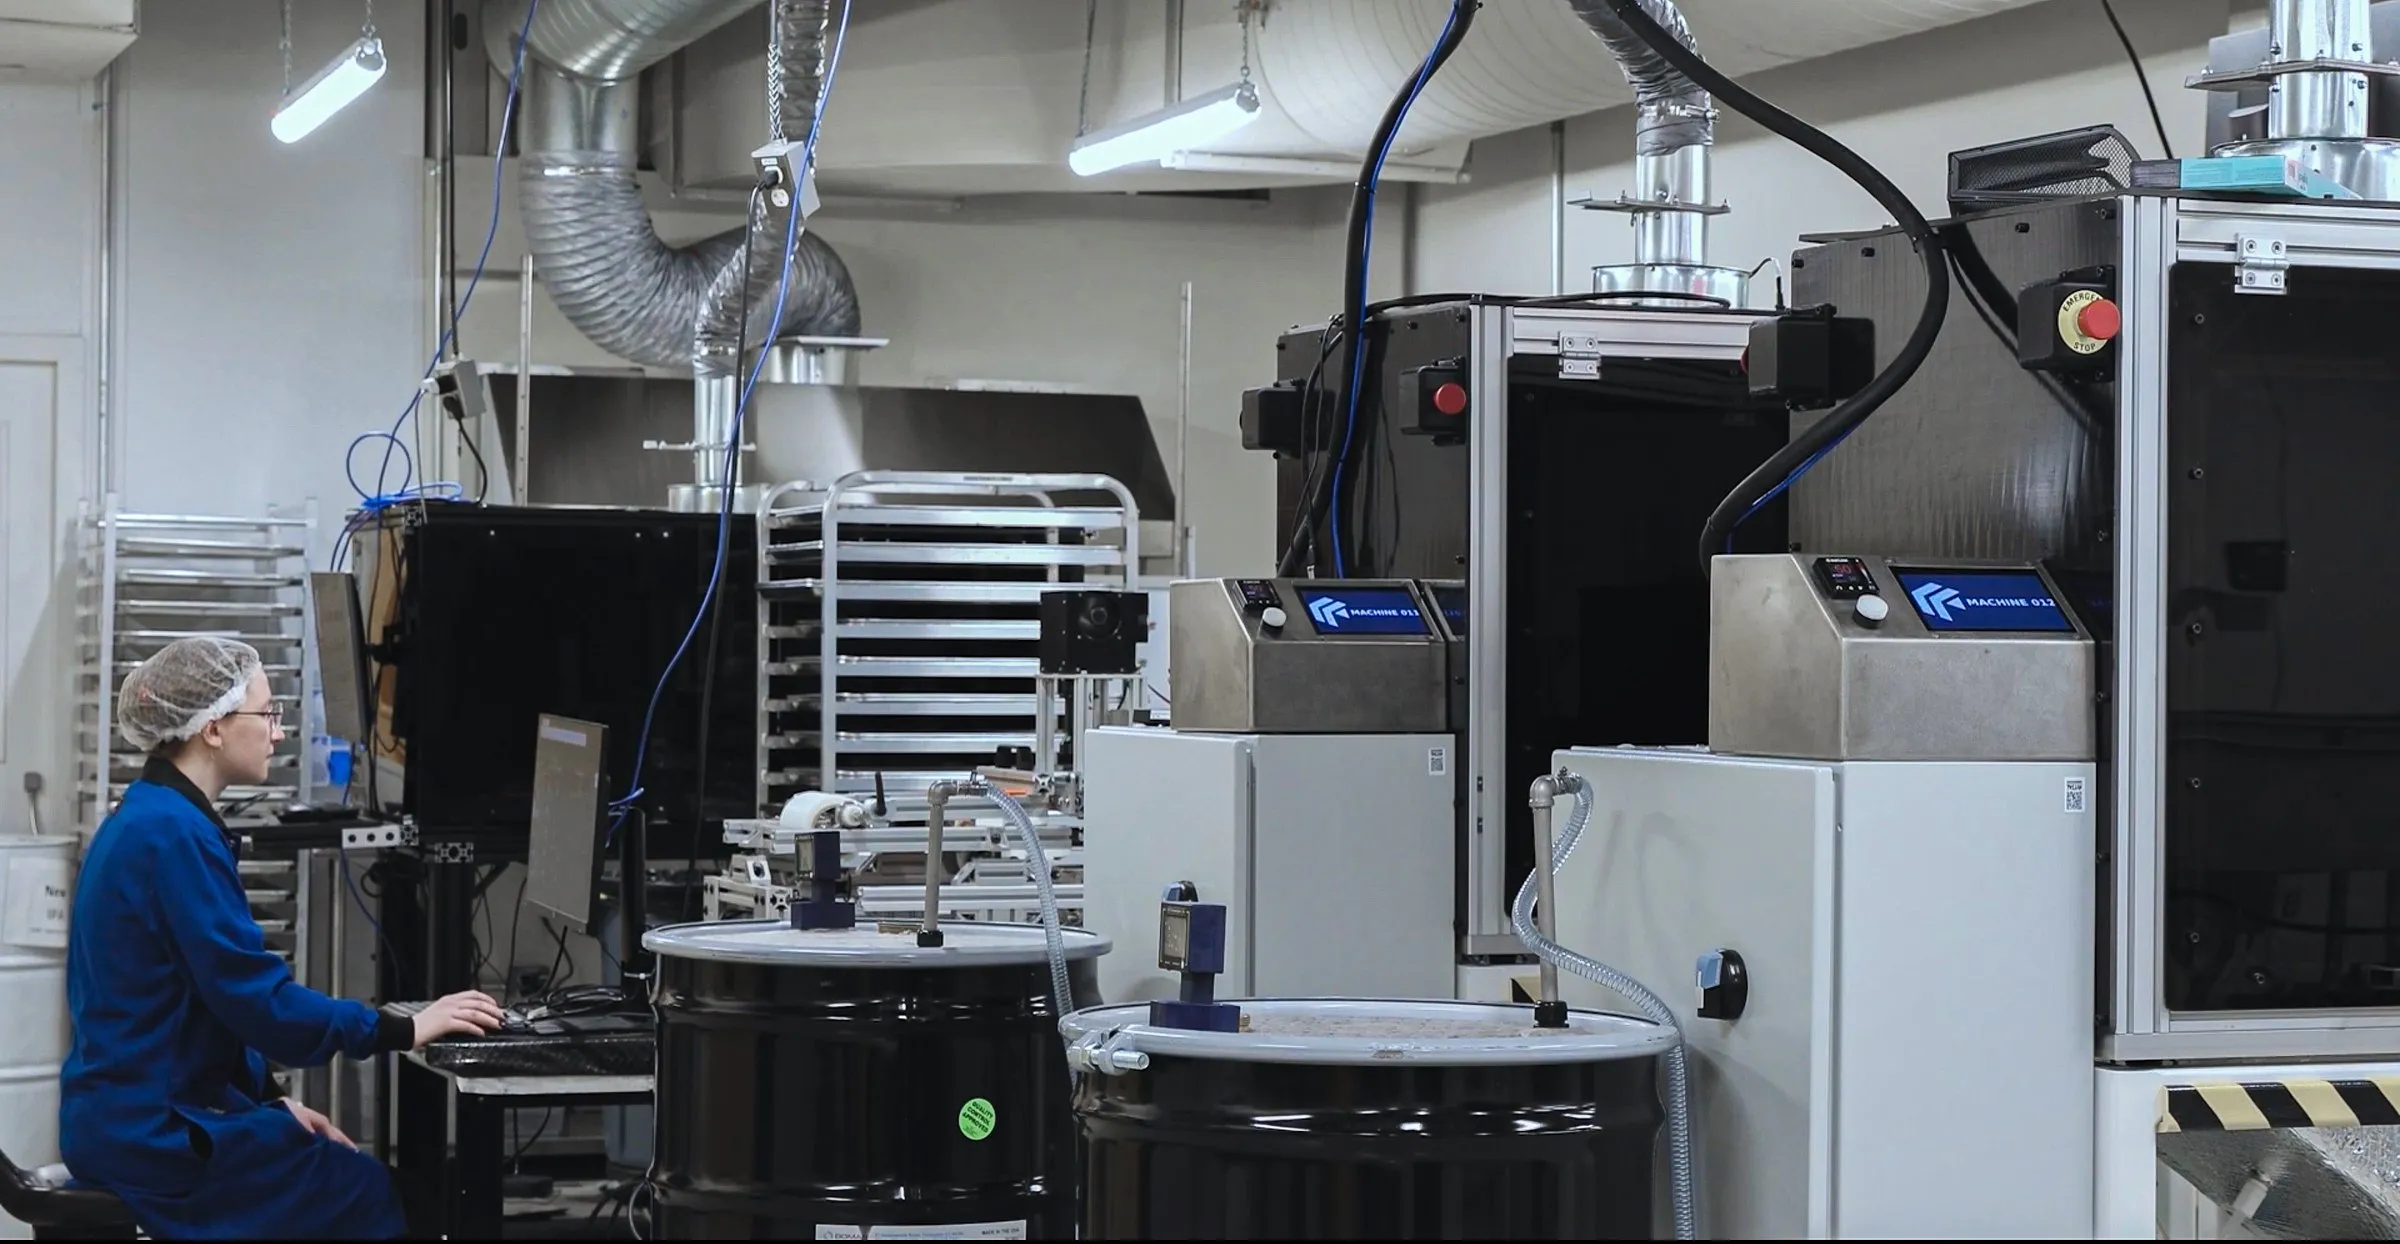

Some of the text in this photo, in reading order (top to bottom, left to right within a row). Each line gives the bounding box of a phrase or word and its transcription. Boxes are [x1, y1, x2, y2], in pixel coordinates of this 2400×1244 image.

[2063, 292, 2100, 312] EMERGE
[2073, 341, 2096, 352] STOP
[1965, 598, 2056, 607] MACHINE 012
[1350, 608, 1420, 617] MACHINE 011
[967, 1106, 990, 1126] CONTROL
[972, 1101, 993, 1119] QUALITY
[962, 1112, 989, 1133] APPROVED
